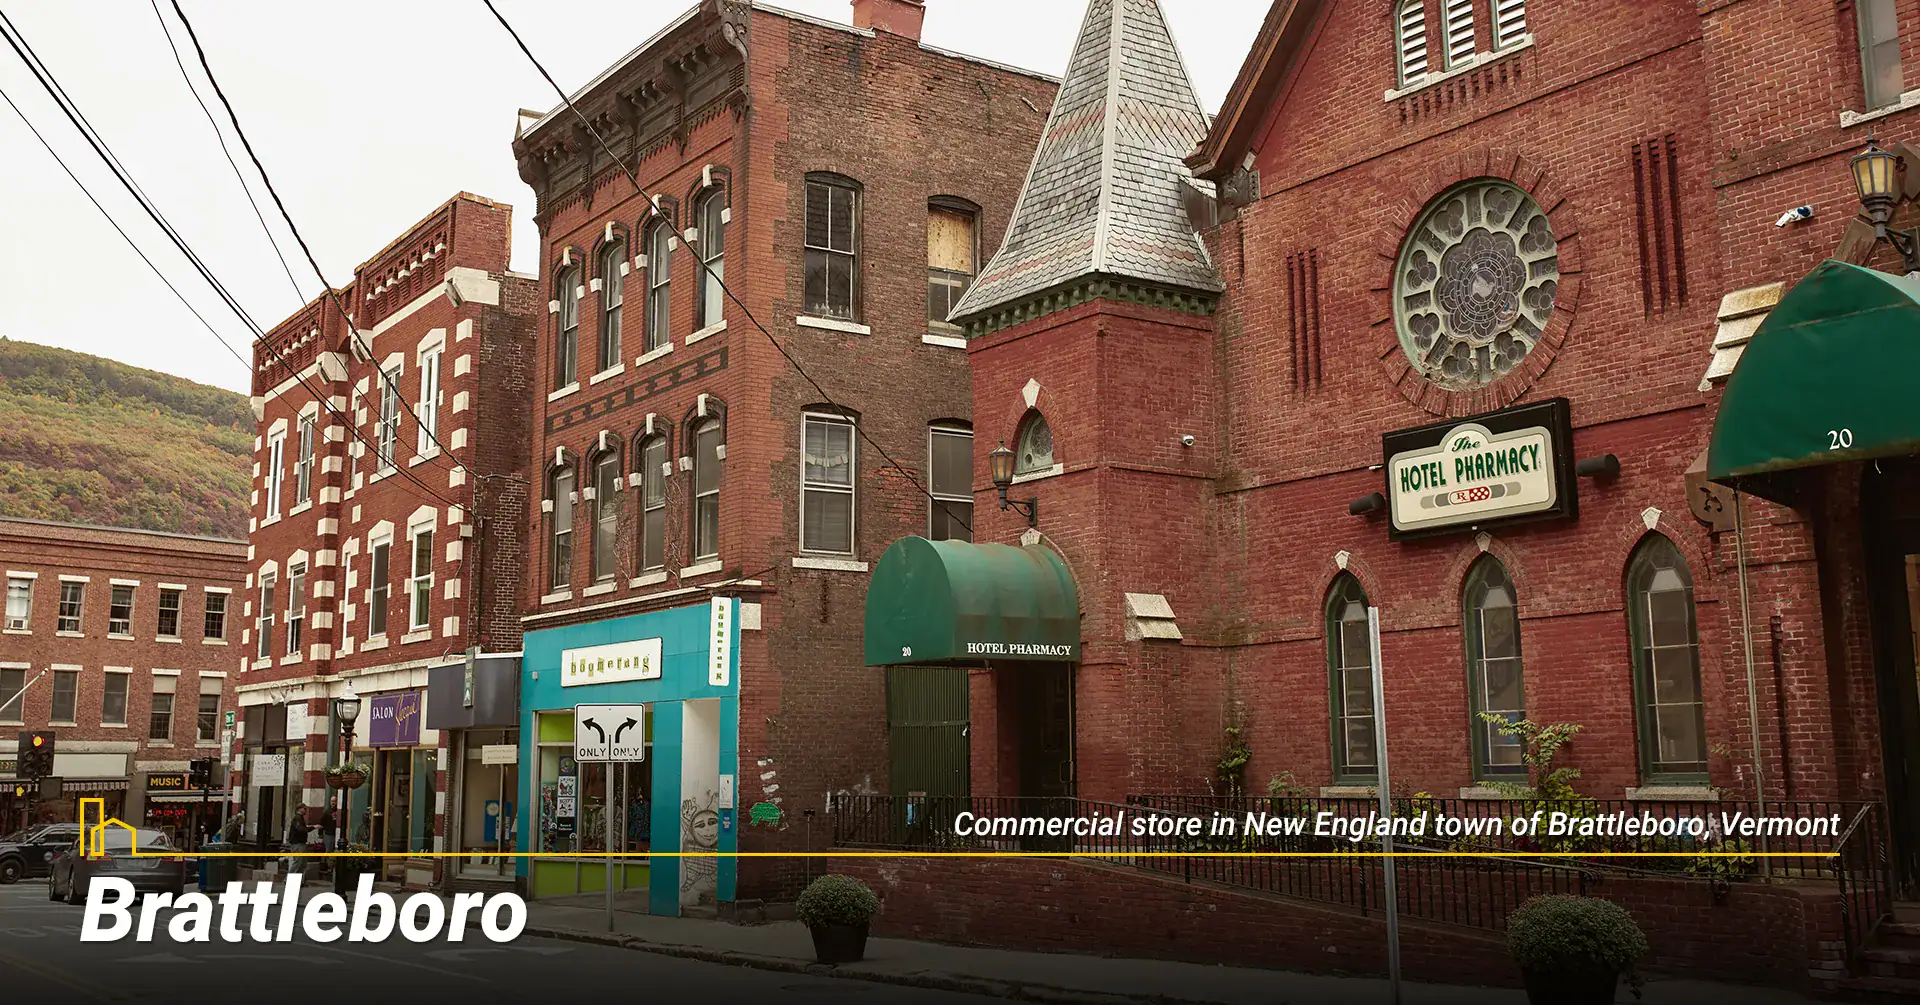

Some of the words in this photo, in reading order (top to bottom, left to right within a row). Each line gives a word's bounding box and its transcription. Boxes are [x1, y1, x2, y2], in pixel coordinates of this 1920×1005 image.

[1451, 435, 1480, 452] The
[1827, 428, 1853, 450] 20
[1400, 461, 1446, 492] HOTEL
[1455, 443, 1539, 482] PHARMACY
[902, 646, 912, 657] 20
[967, 642, 1008, 655] HOTEL
[1009, 643, 1072, 656] PHARMACY
[570, 652, 650, 677] boomerang
[372, 706, 394, 720] SALON
[579, 747, 607, 757] ONLY
[613, 747, 640, 757] ONLY
[150, 777, 182, 788] MUSIC
